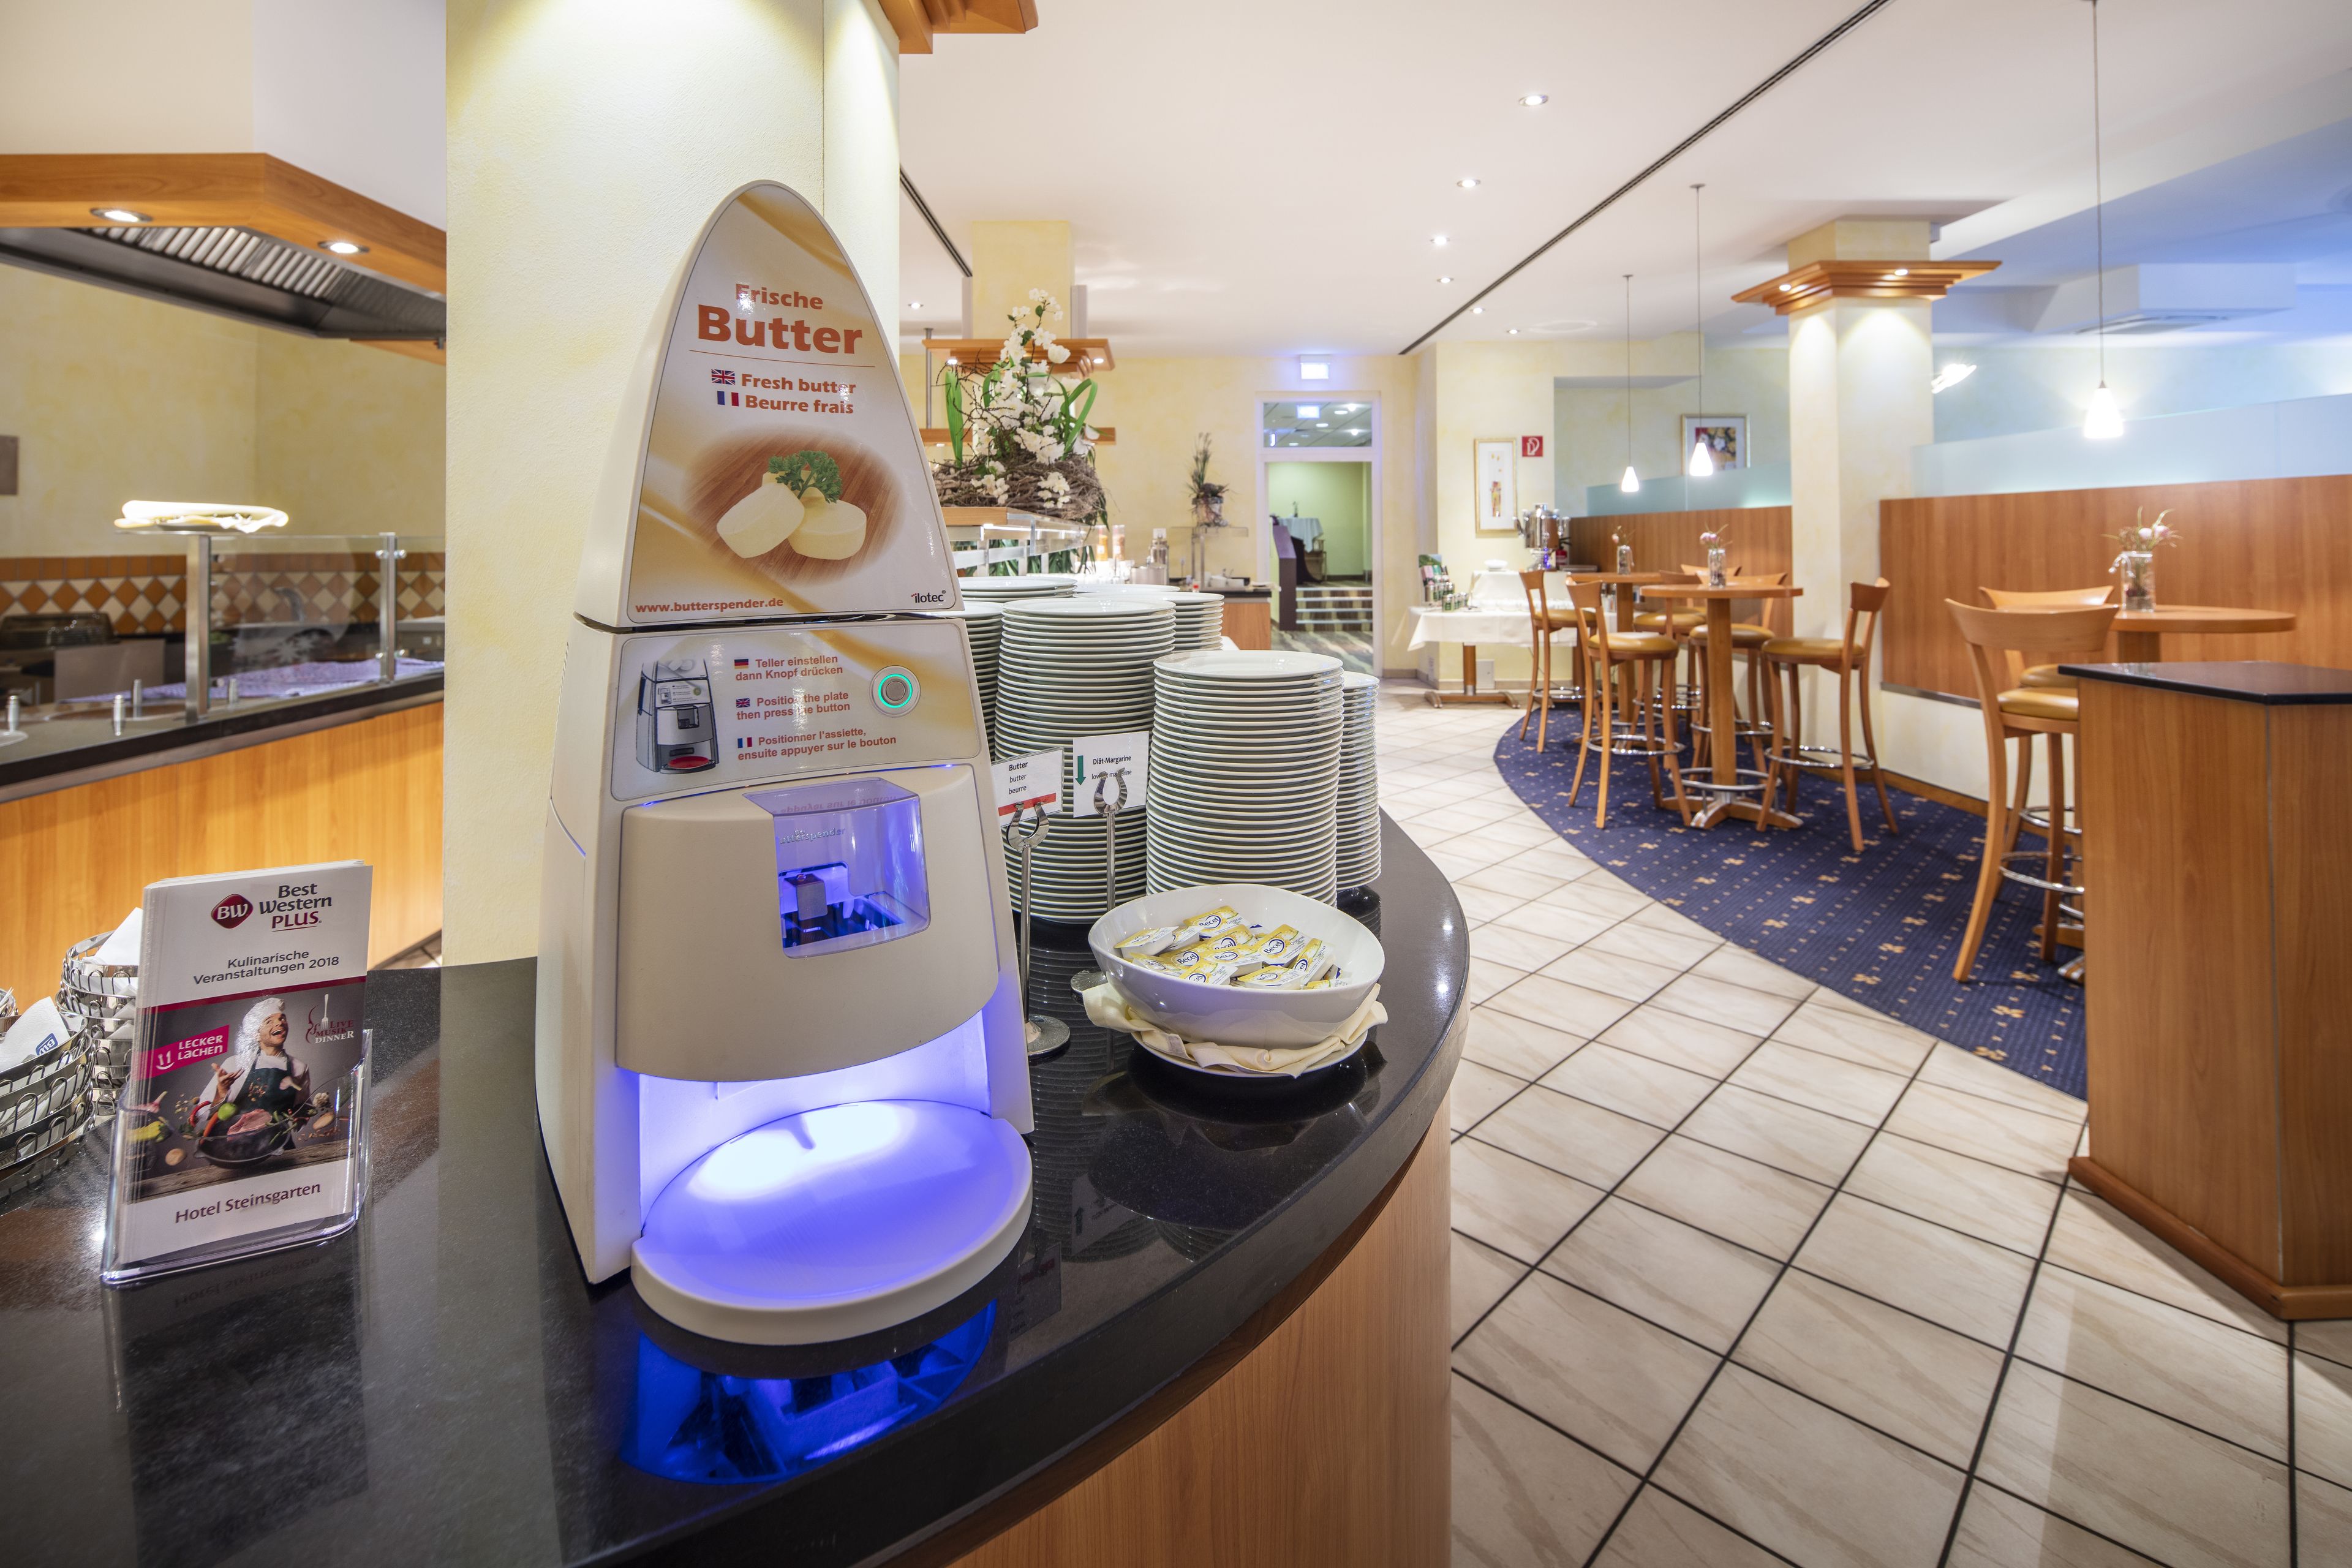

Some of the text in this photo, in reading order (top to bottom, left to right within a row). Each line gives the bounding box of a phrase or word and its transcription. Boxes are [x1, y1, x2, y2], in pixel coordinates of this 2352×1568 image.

[736, 284, 823, 310] Frische
[698, 304, 862, 354] Butter
[741, 374, 856, 394] Fresh butter
[745, 395, 854, 414] Beurre frais
[635, 598, 784, 612] www.butterspender.de
[755, 655, 838, 668] Teller einstellen
[736, 666, 843, 681] dann Knopf drücken
[757, 692, 849, 706] Positio the plate
[737, 710, 761, 720] then
[764, 708, 794, 720] press
[816, 703, 850, 714] button
[758, 732, 816, 746] Positionner
[738, 736, 897, 761] ensuite appuyer sur le bouton
[1009, 762, 1028, 772] Butter
[1093, 755, 1131, 765] Diät-Margarine
[1009, 774, 1027, 783] butter
[1009, 786, 1027, 795] beurre
[780, 828, 845, 845] utterspender
[278, 883, 317, 899] Best
[217, 903, 249, 920] BW
[259, 896, 333, 914] Western
[1264, 941, 1283, 954] Becel
[227, 951, 309, 969] Kulinarische
[1177, 951, 1198, 965] Becel
[194, 956, 339, 985] Veranstaltungen 2018
[330, 1019, 354, 1030] LIVE
[314, 1031, 355, 1044] DINNER
[315, 1027, 347, 1038] MUSIK
[175, 1183, 321, 1224] Hotel Steinsgarten
